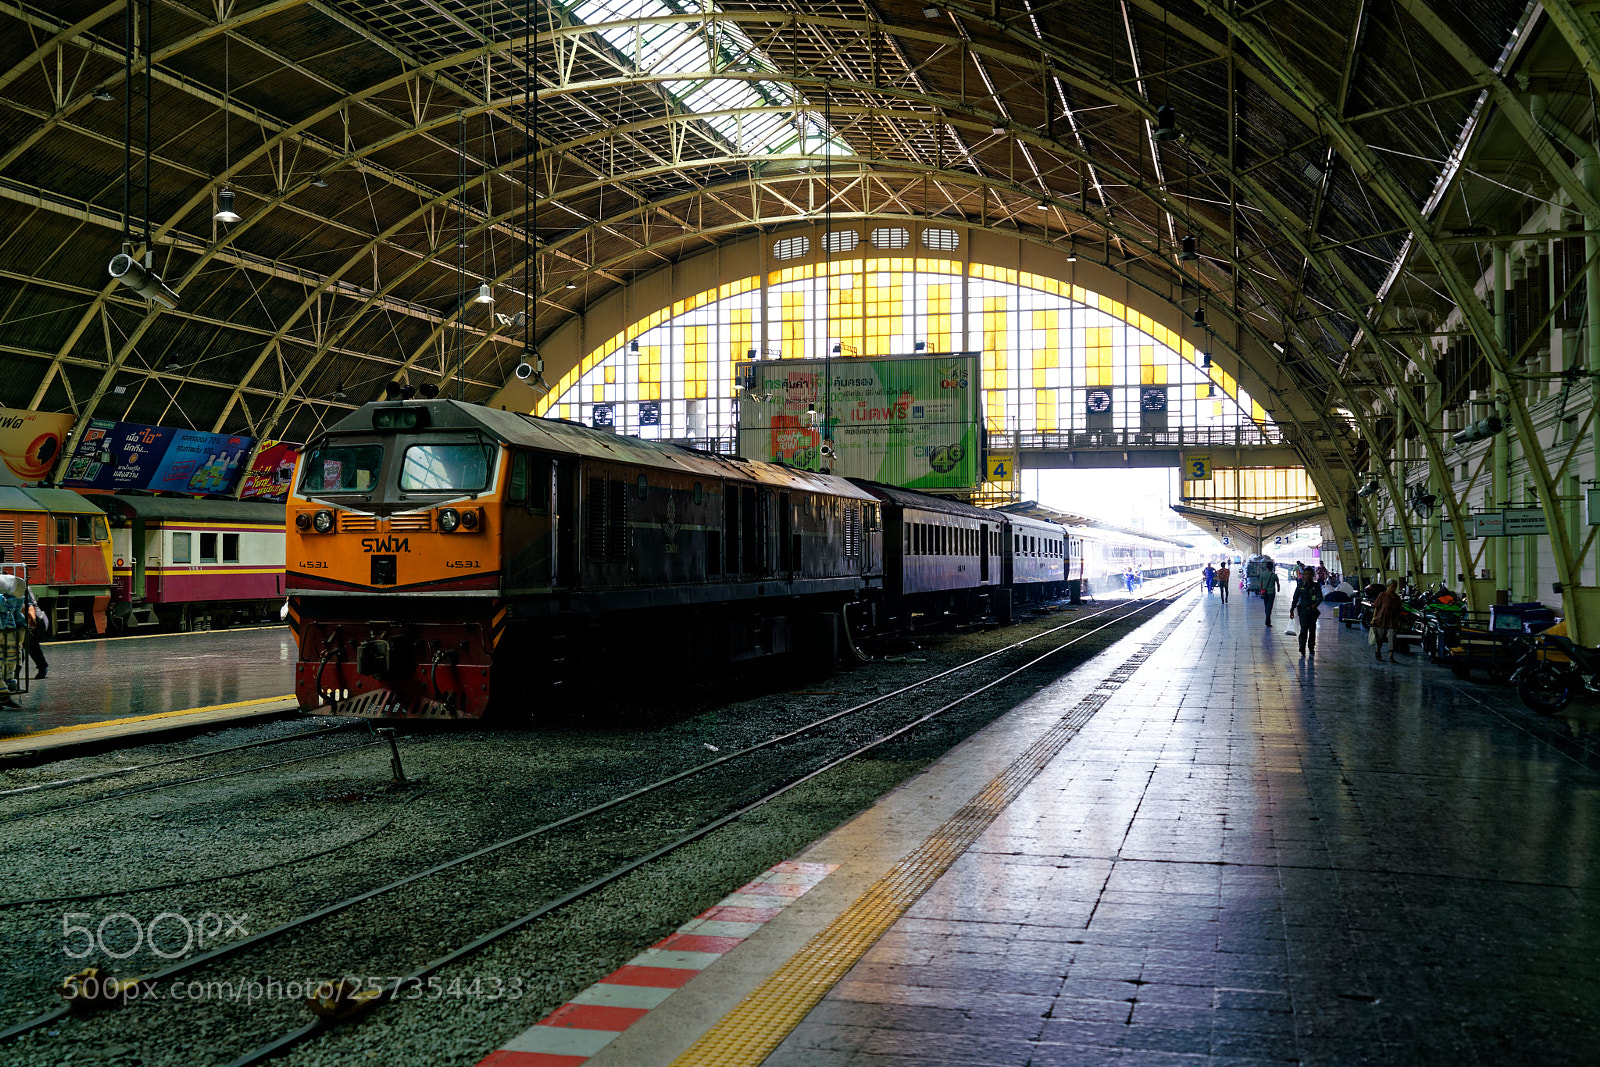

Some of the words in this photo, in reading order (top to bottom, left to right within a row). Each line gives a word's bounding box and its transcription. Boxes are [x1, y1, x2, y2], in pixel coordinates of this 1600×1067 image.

[852, 401, 907, 421] เน็ตฟรี
[994, 463, 1007, 478] 4
[1192, 461, 1205, 478] 3
[361, 534, 411, 553] ร.ฟ.ท.
[1223, 537, 1230, 545] 3
[1275, 536, 1282, 544] 2
[299, 561, 329, 569] 4531
[446, 560, 481, 569] 4531
